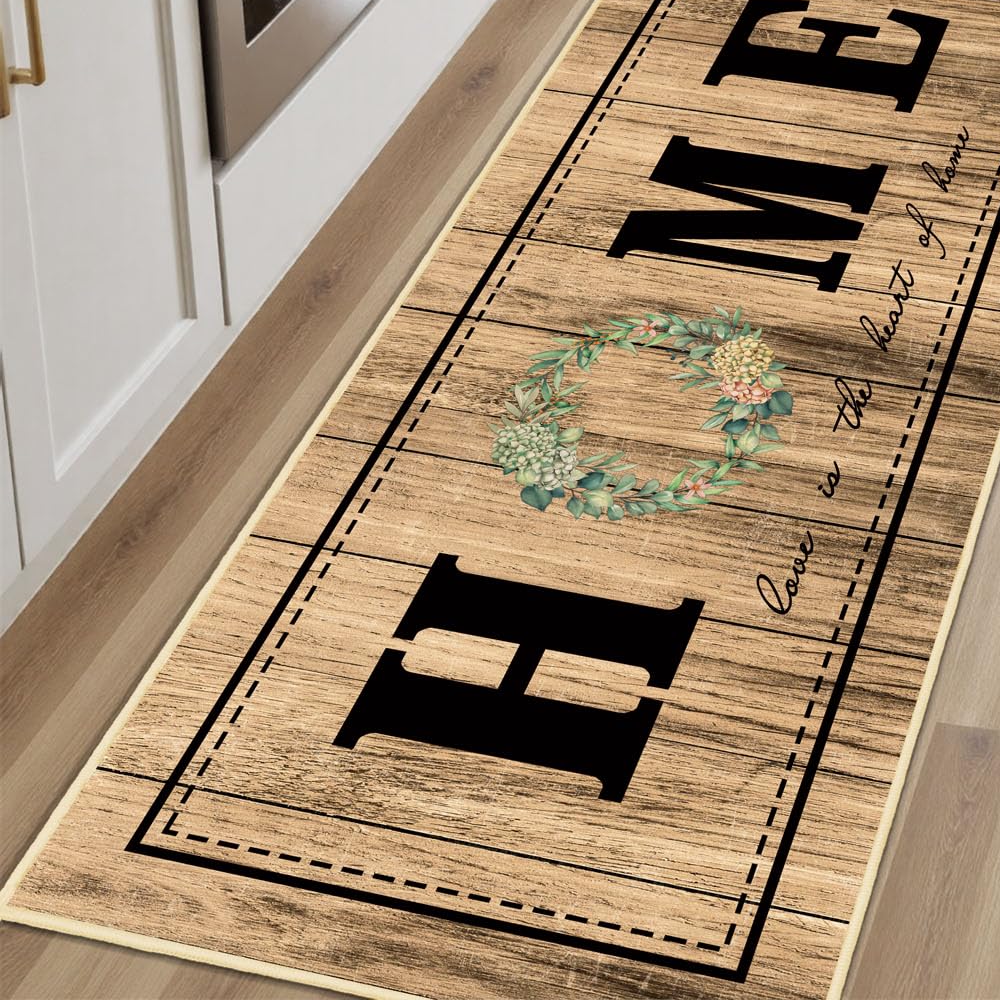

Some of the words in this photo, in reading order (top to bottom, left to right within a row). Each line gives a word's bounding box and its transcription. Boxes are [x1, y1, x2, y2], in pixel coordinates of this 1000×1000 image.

[920, 126, 969, 193] home
[904, 202, 947, 260] of
[858, 259, 914, 353] heart
[832, 376, 873, 433] the
[817, 460, 842, 500] is
[756, 530, 814, 616] love
